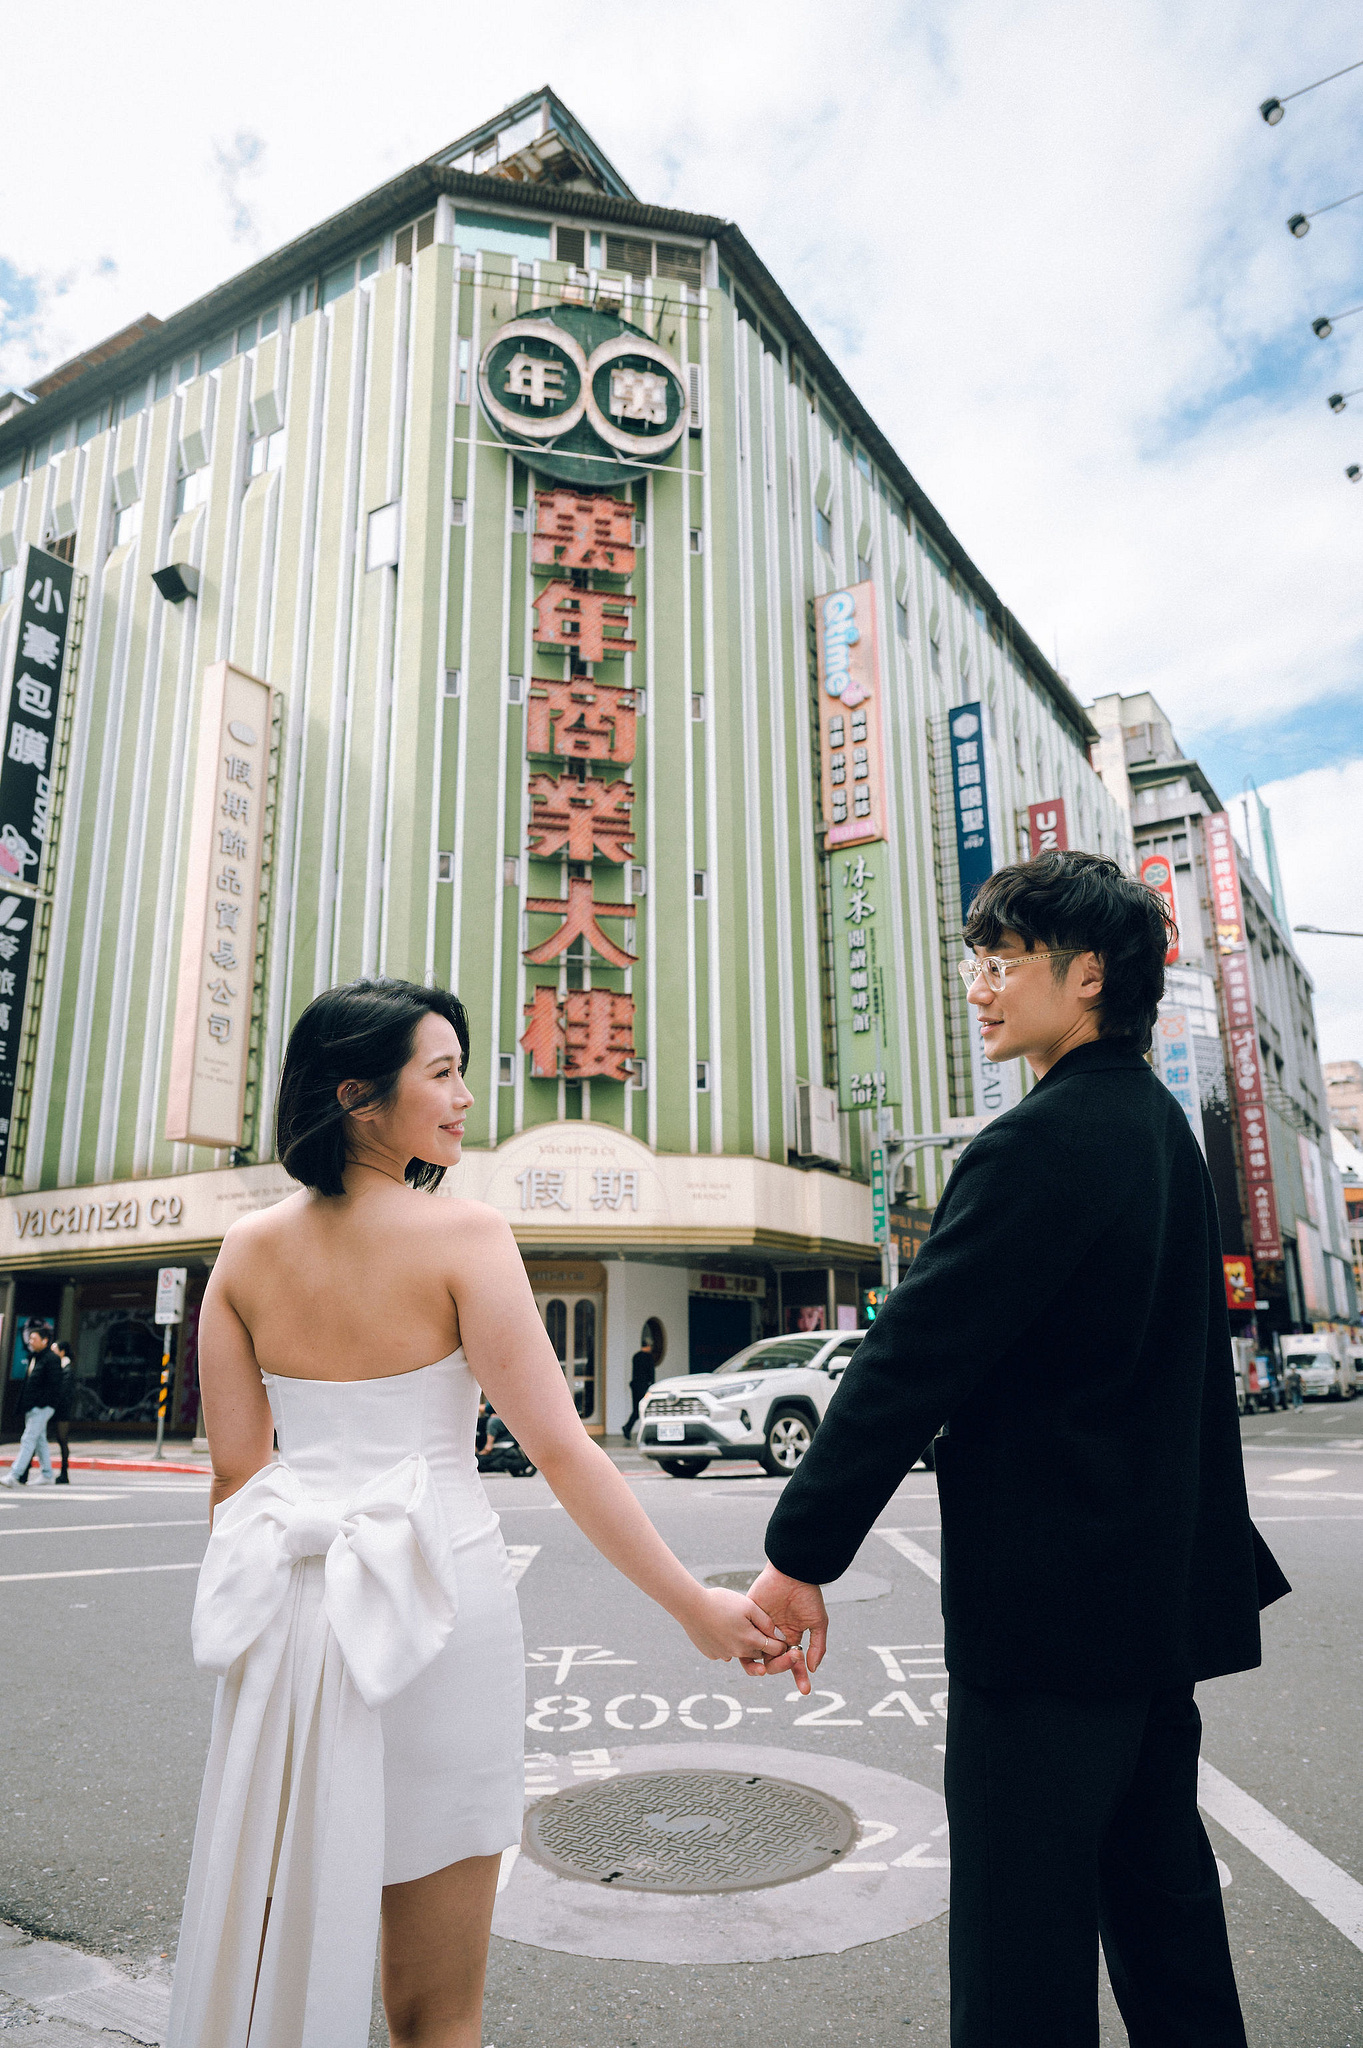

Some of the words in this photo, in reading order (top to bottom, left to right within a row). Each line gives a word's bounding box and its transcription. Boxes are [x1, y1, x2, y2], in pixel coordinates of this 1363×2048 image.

[519, 487, 640, 1082] 萬年商業大樓
[207, 753, 255, 1044] 假期飾品貿易公司
[12, 1199, 140, 1239] vacanza
[515, 1168, 639, 1212] 假期
